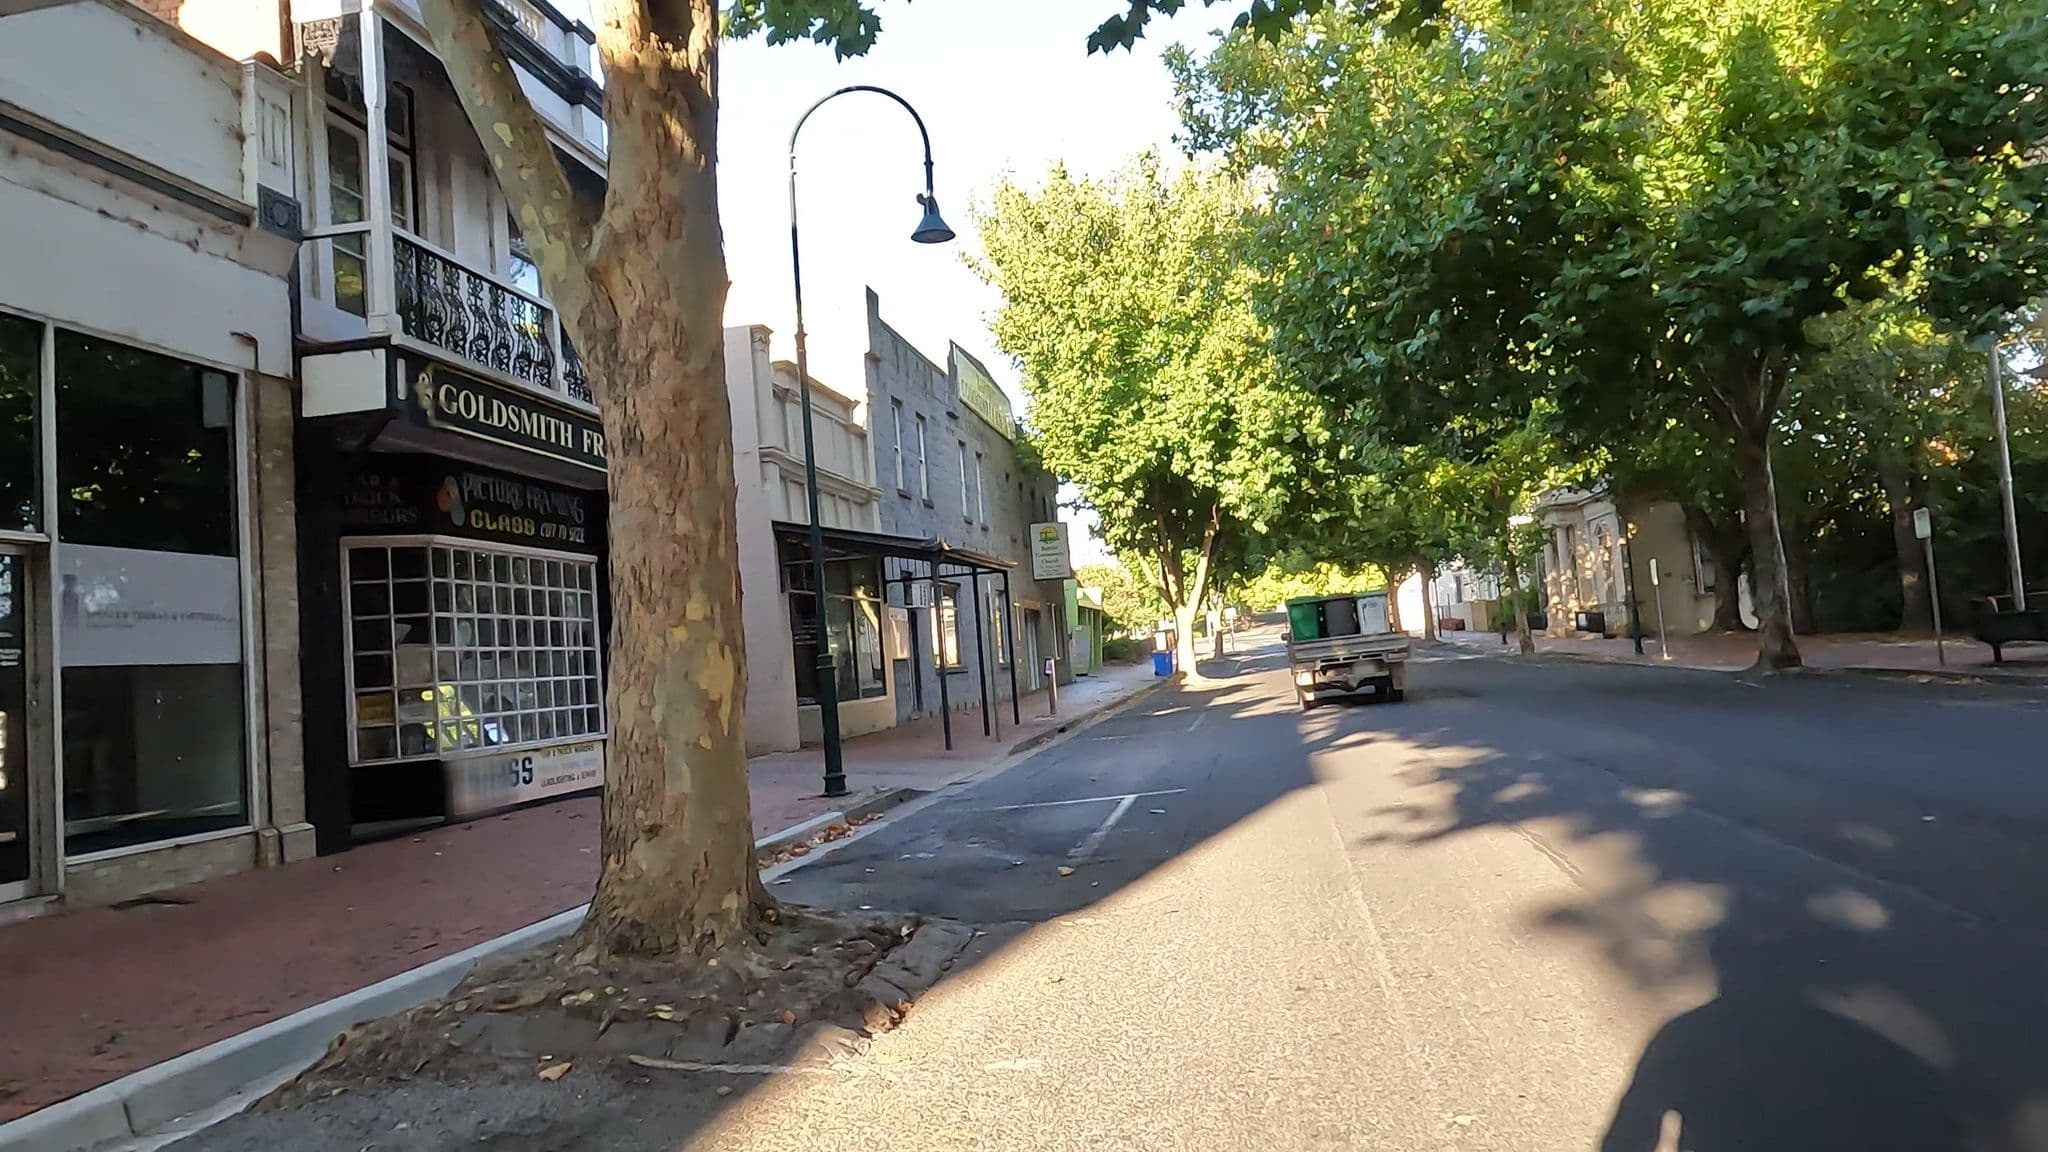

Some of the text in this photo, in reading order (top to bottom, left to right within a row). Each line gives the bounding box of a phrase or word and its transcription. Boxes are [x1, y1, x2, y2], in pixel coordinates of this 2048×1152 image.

[438, 383, 607, 459] GOLDSMITH FR
[463, 472, 585, 524] PICTURE FRAMING
[470, 508, 536, 537] GLASS
